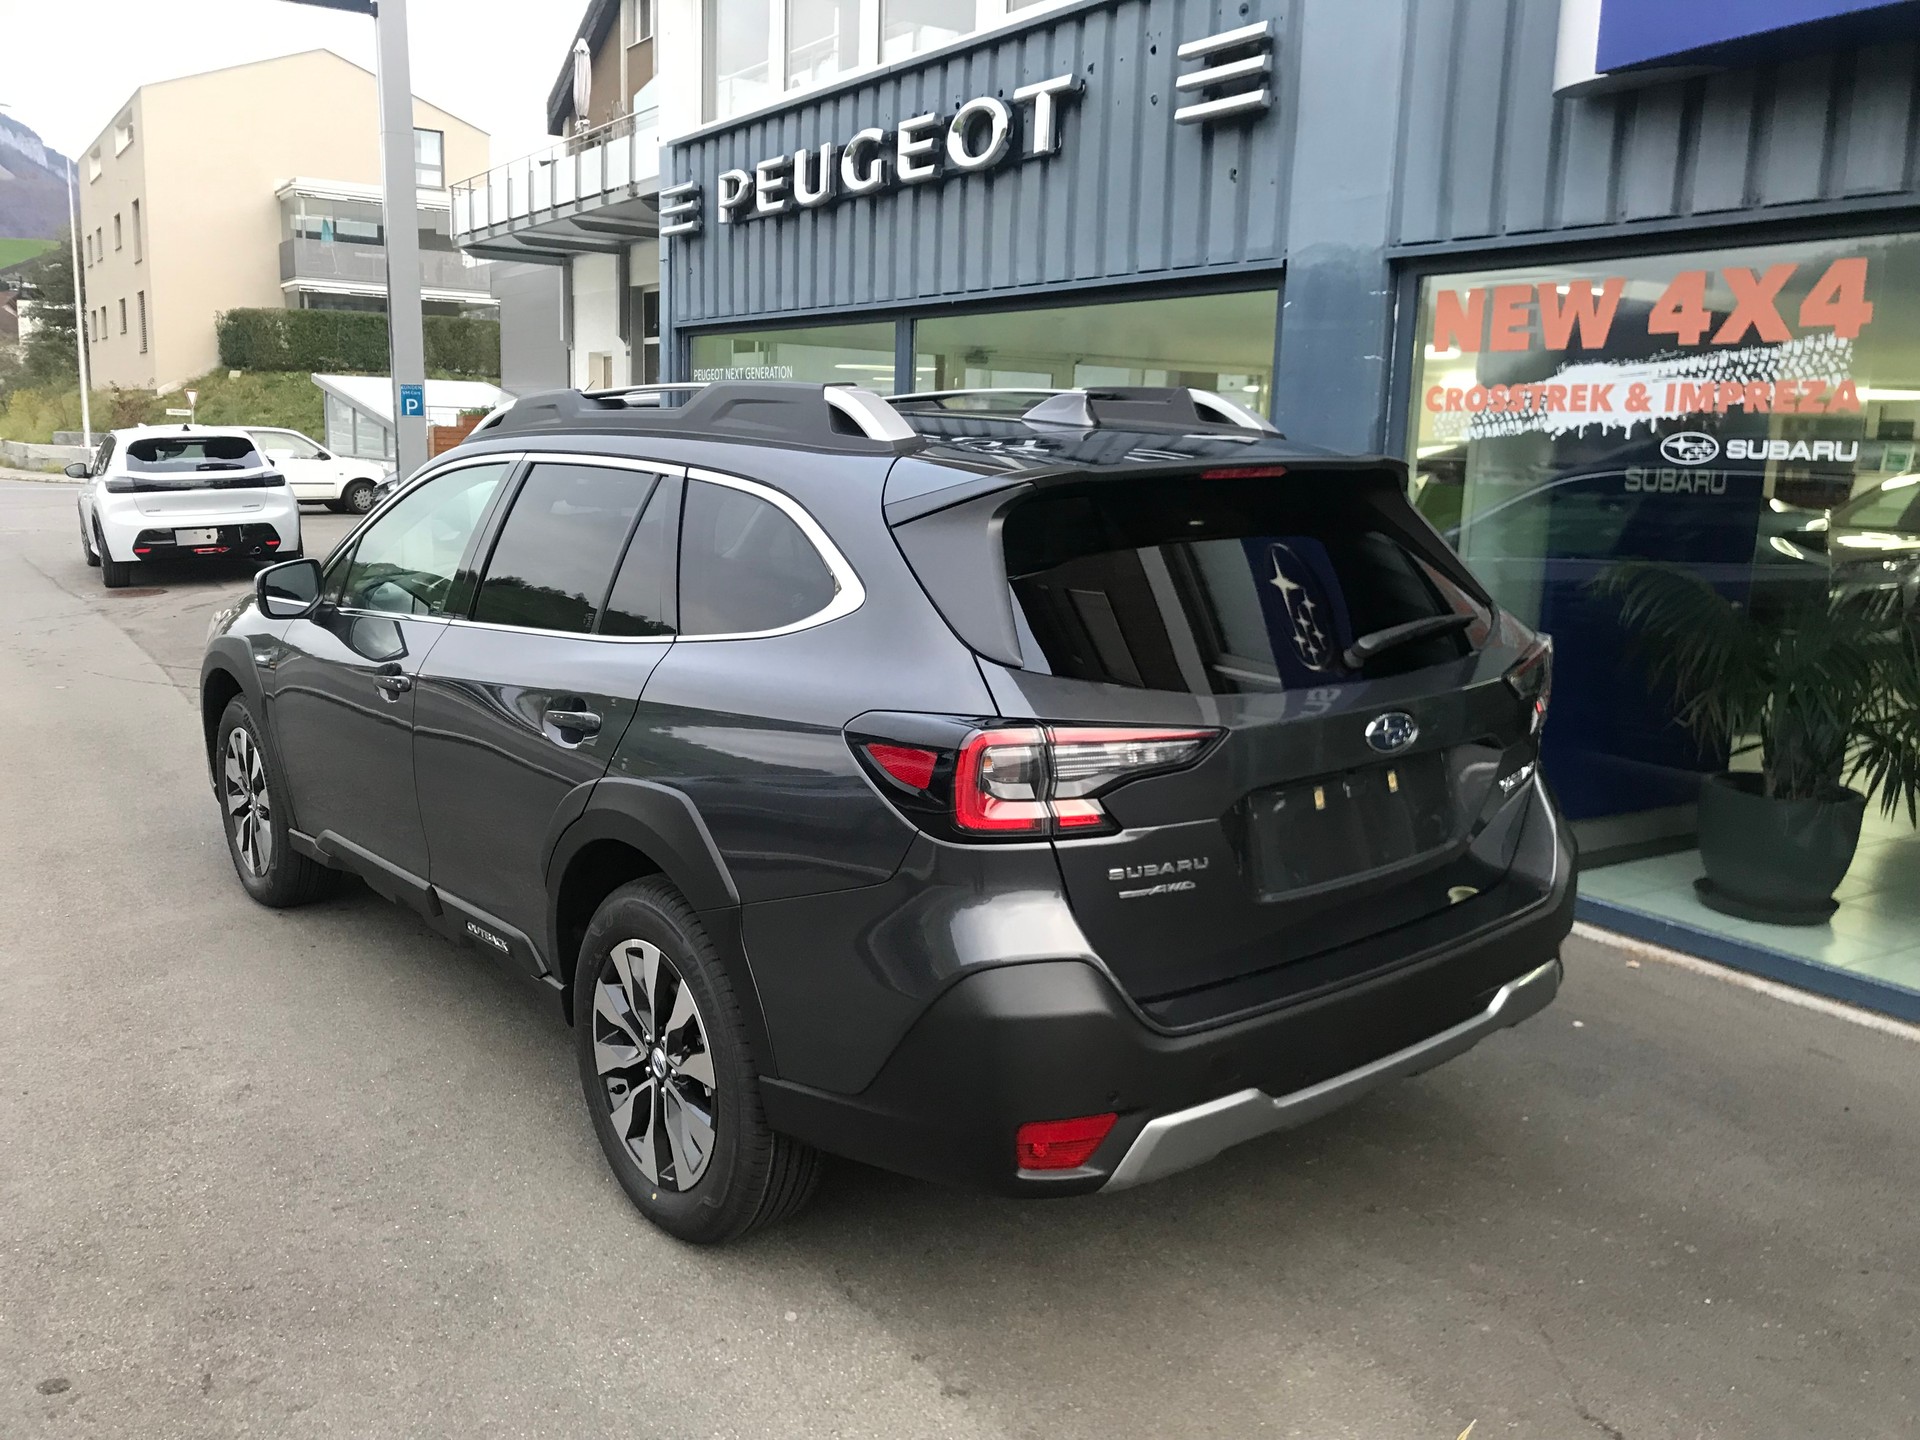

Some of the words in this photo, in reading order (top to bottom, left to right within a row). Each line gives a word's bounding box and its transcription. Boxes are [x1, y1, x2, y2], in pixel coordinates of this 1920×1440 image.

[718, 73, 1083, 225] PEUGEOT
[1433, 277, 1626, 352] NEW
[1647, 257, 1874, 346] 4X4
[693, 368, 723, 381] PEUGEOT
[725, 367, 744, 380] NEXT
[745, 365, 793, 379] GENERATION
[1425, 383, 1615, 414] CROSSTREK
[1625, 383, 1653, 413] &
[1665, 379, 1861, 414] IMPREZA
[1726, 439, 1859, 462] SUBARU
[1624, 466, 1727, 495] SUBARU
[1108, 857, 1209, 881] SUBARU
